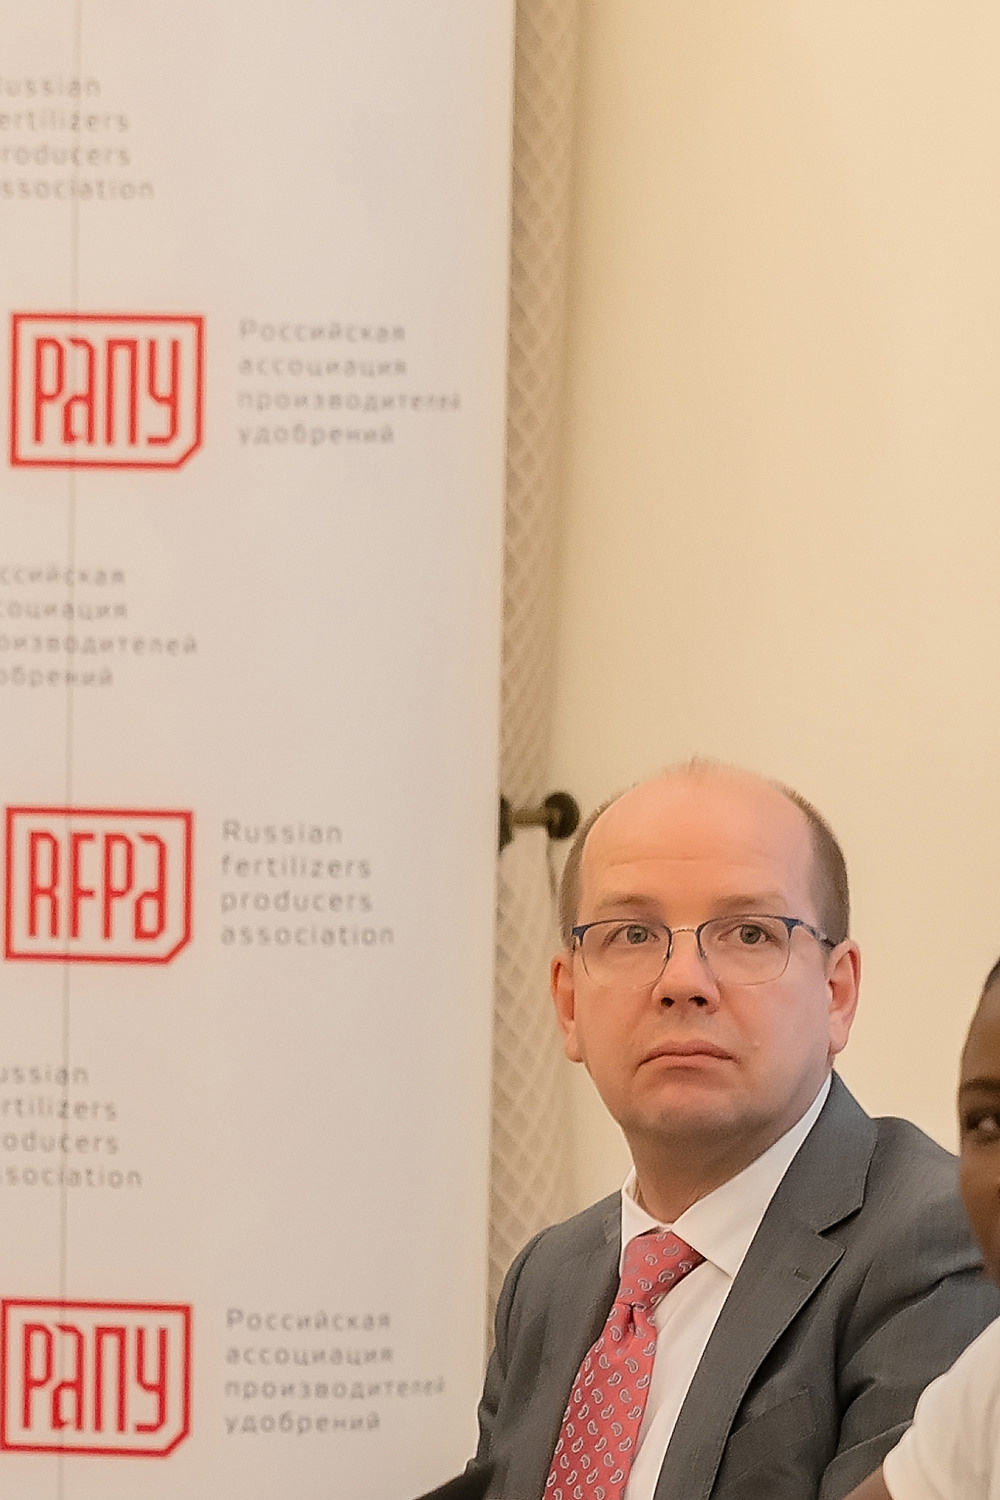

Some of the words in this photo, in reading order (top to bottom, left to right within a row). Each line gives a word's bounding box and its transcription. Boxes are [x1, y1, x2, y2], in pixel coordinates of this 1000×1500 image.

[0, 75, 101, 98] ussian
[239, 317, 406, 342] Российская
[238, 356, 407, 378] ассоциация
[237, 422, 395, 446] удобрений
[0, 600, 128, 621] оциация
[222, 819, 343, 844] Russian
[221, 853, 372, 878] fertilizers
[221, 889, 374, 914] producers
[220, 924, 395, 947] association
[0, 1164, 143, 1189] sociation
[226, 1307, 391, 1331] Российская
[225, 1344, 394, 1367] ассоциация
[225, 1410, 381, 1436] удобрений
